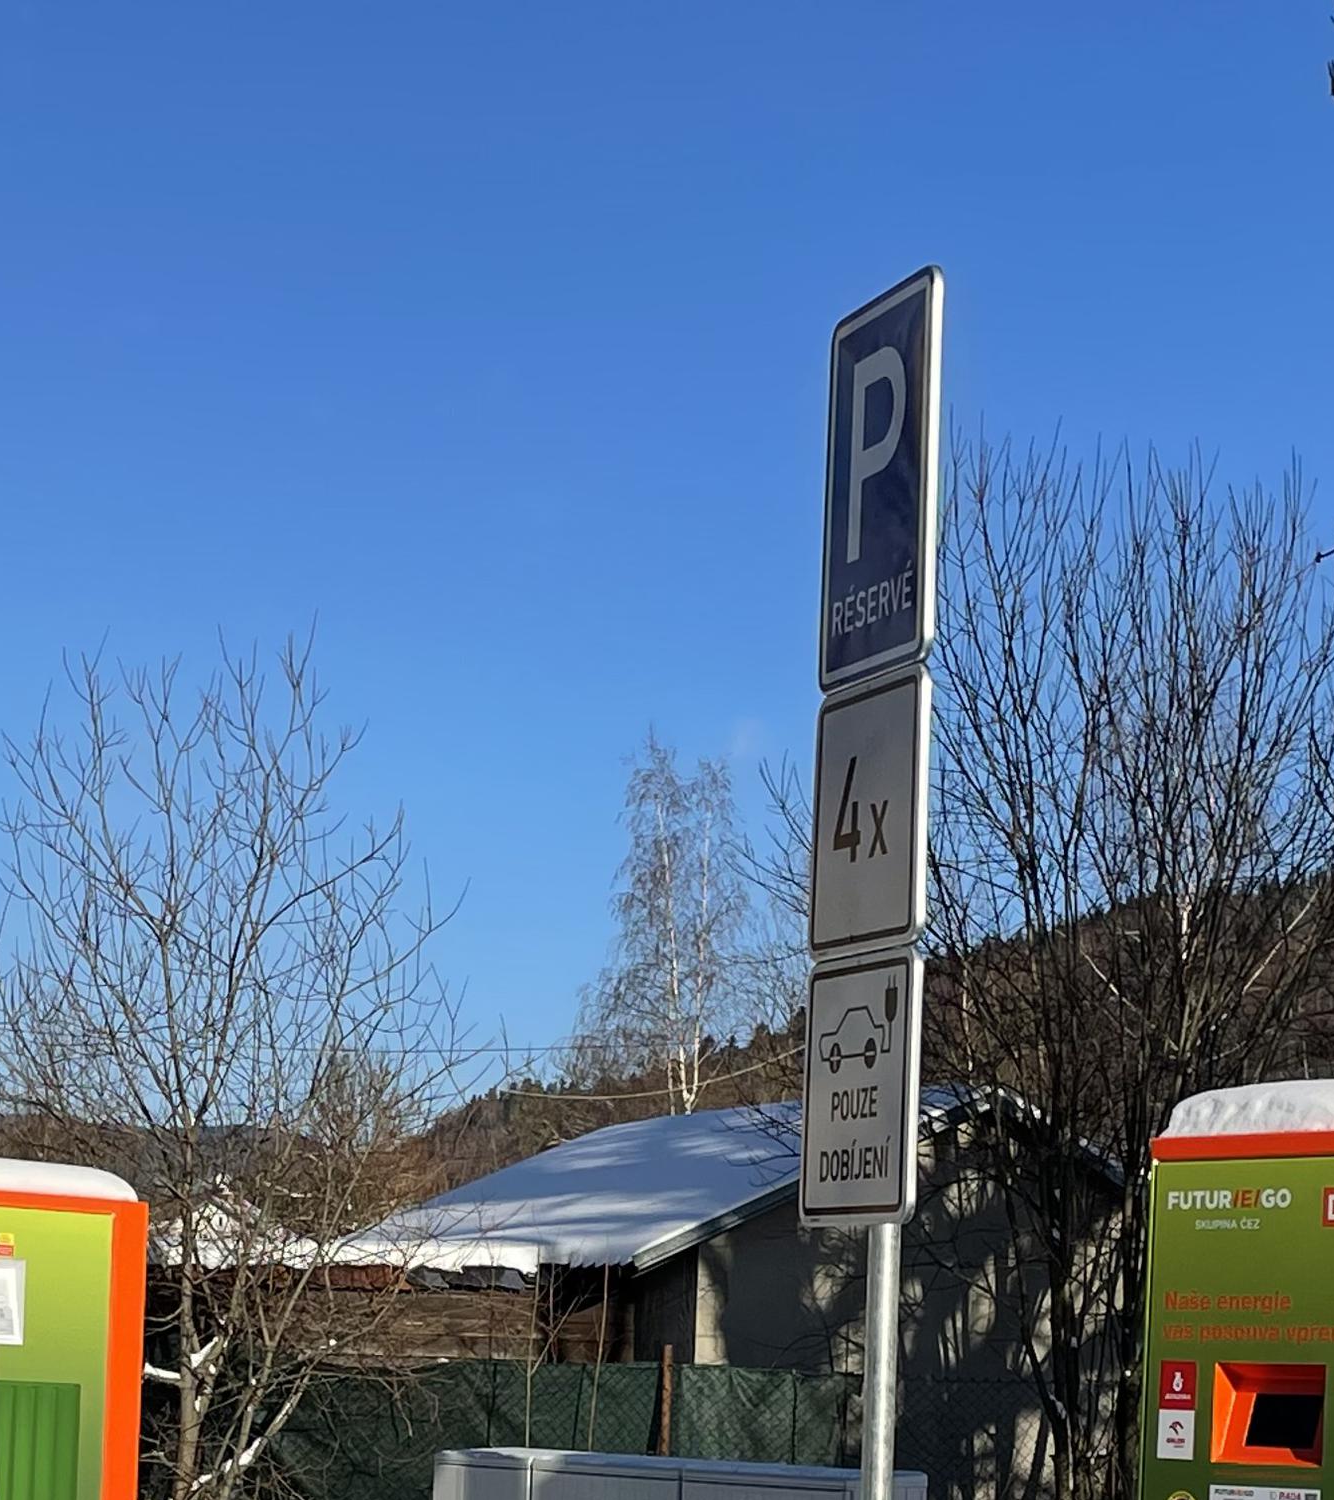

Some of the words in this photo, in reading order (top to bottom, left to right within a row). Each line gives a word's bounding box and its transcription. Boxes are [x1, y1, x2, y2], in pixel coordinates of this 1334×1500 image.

[847, 346, 907, 564] P
[831, 560, 914, 638] RÉSERVÉ
[830, 1085, 878, 1122] POUZE
[819, 1135, 891, 1183] DOBÍJENÍ
[1165, 1289, 1211, 1311] Naše
[1217, 1290, 1292, 1314] energie
